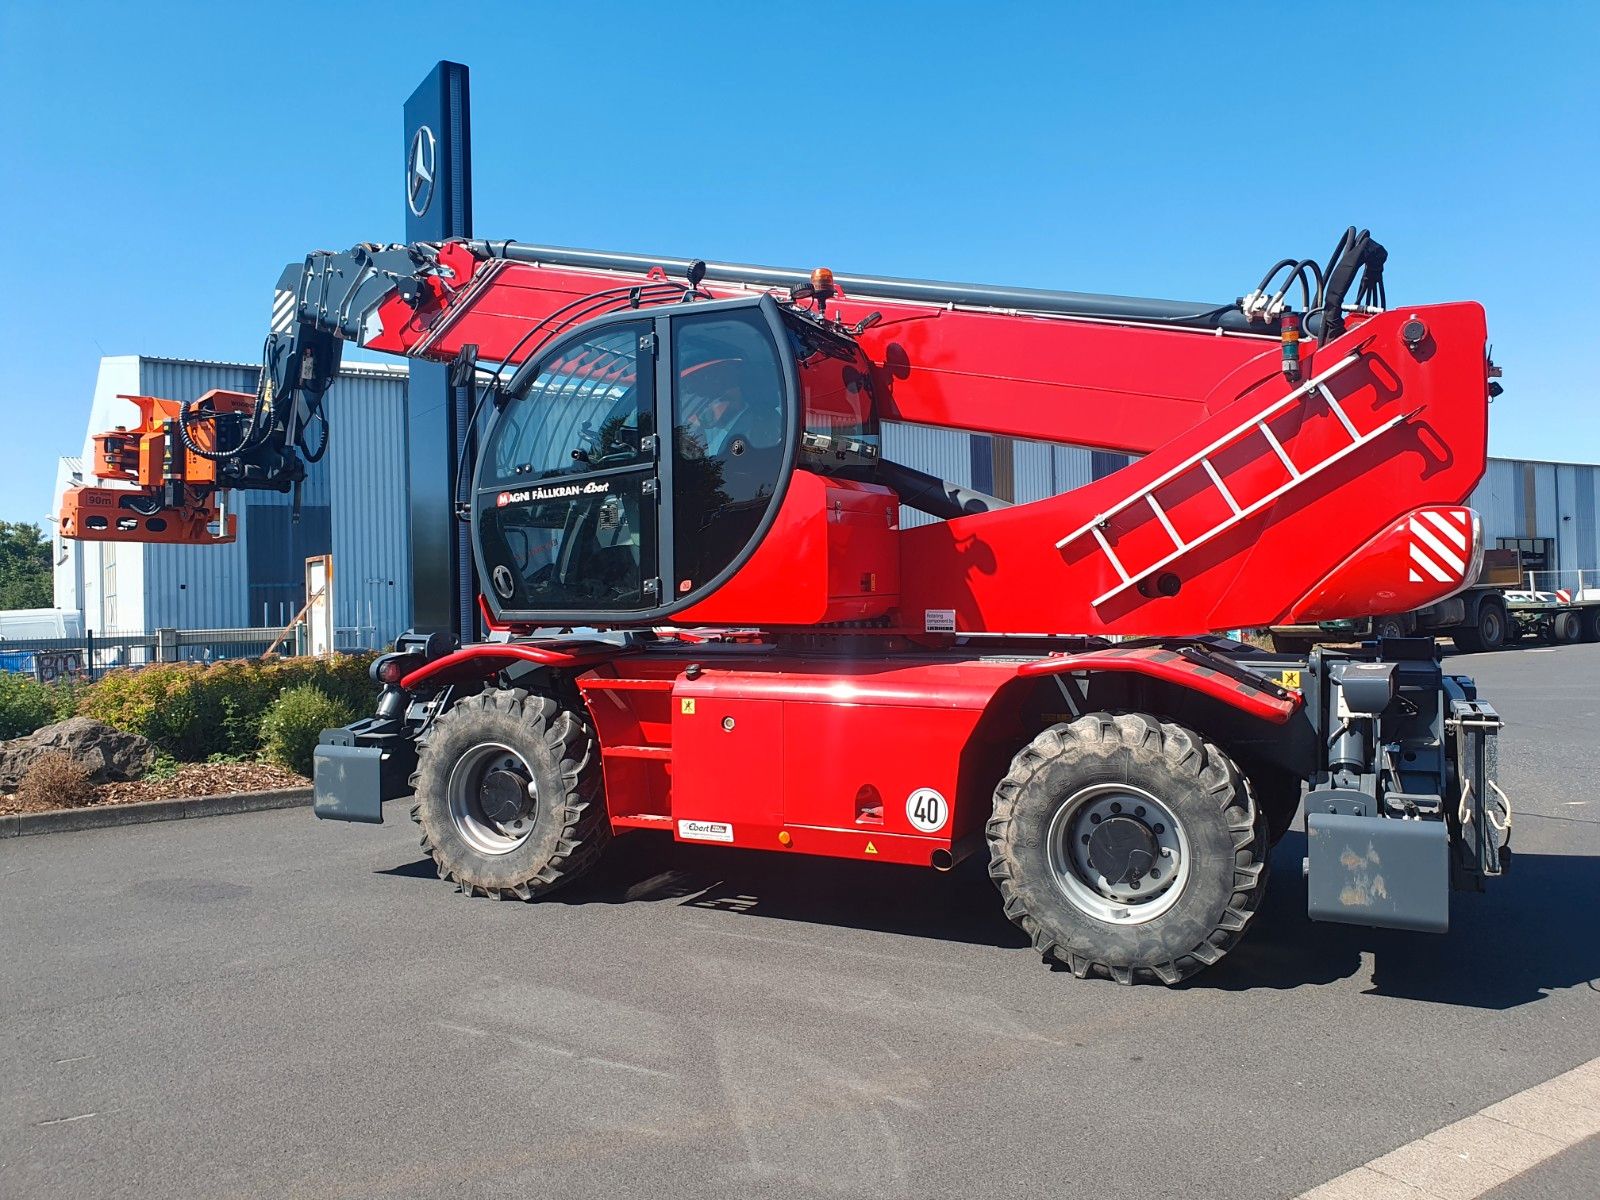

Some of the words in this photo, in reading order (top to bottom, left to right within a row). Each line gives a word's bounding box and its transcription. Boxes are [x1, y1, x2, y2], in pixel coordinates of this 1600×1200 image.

[89, 495, 112, 504] 90m
[499, 491, 530, 504] MAGNI
[914, 796, 939, 824] 40
